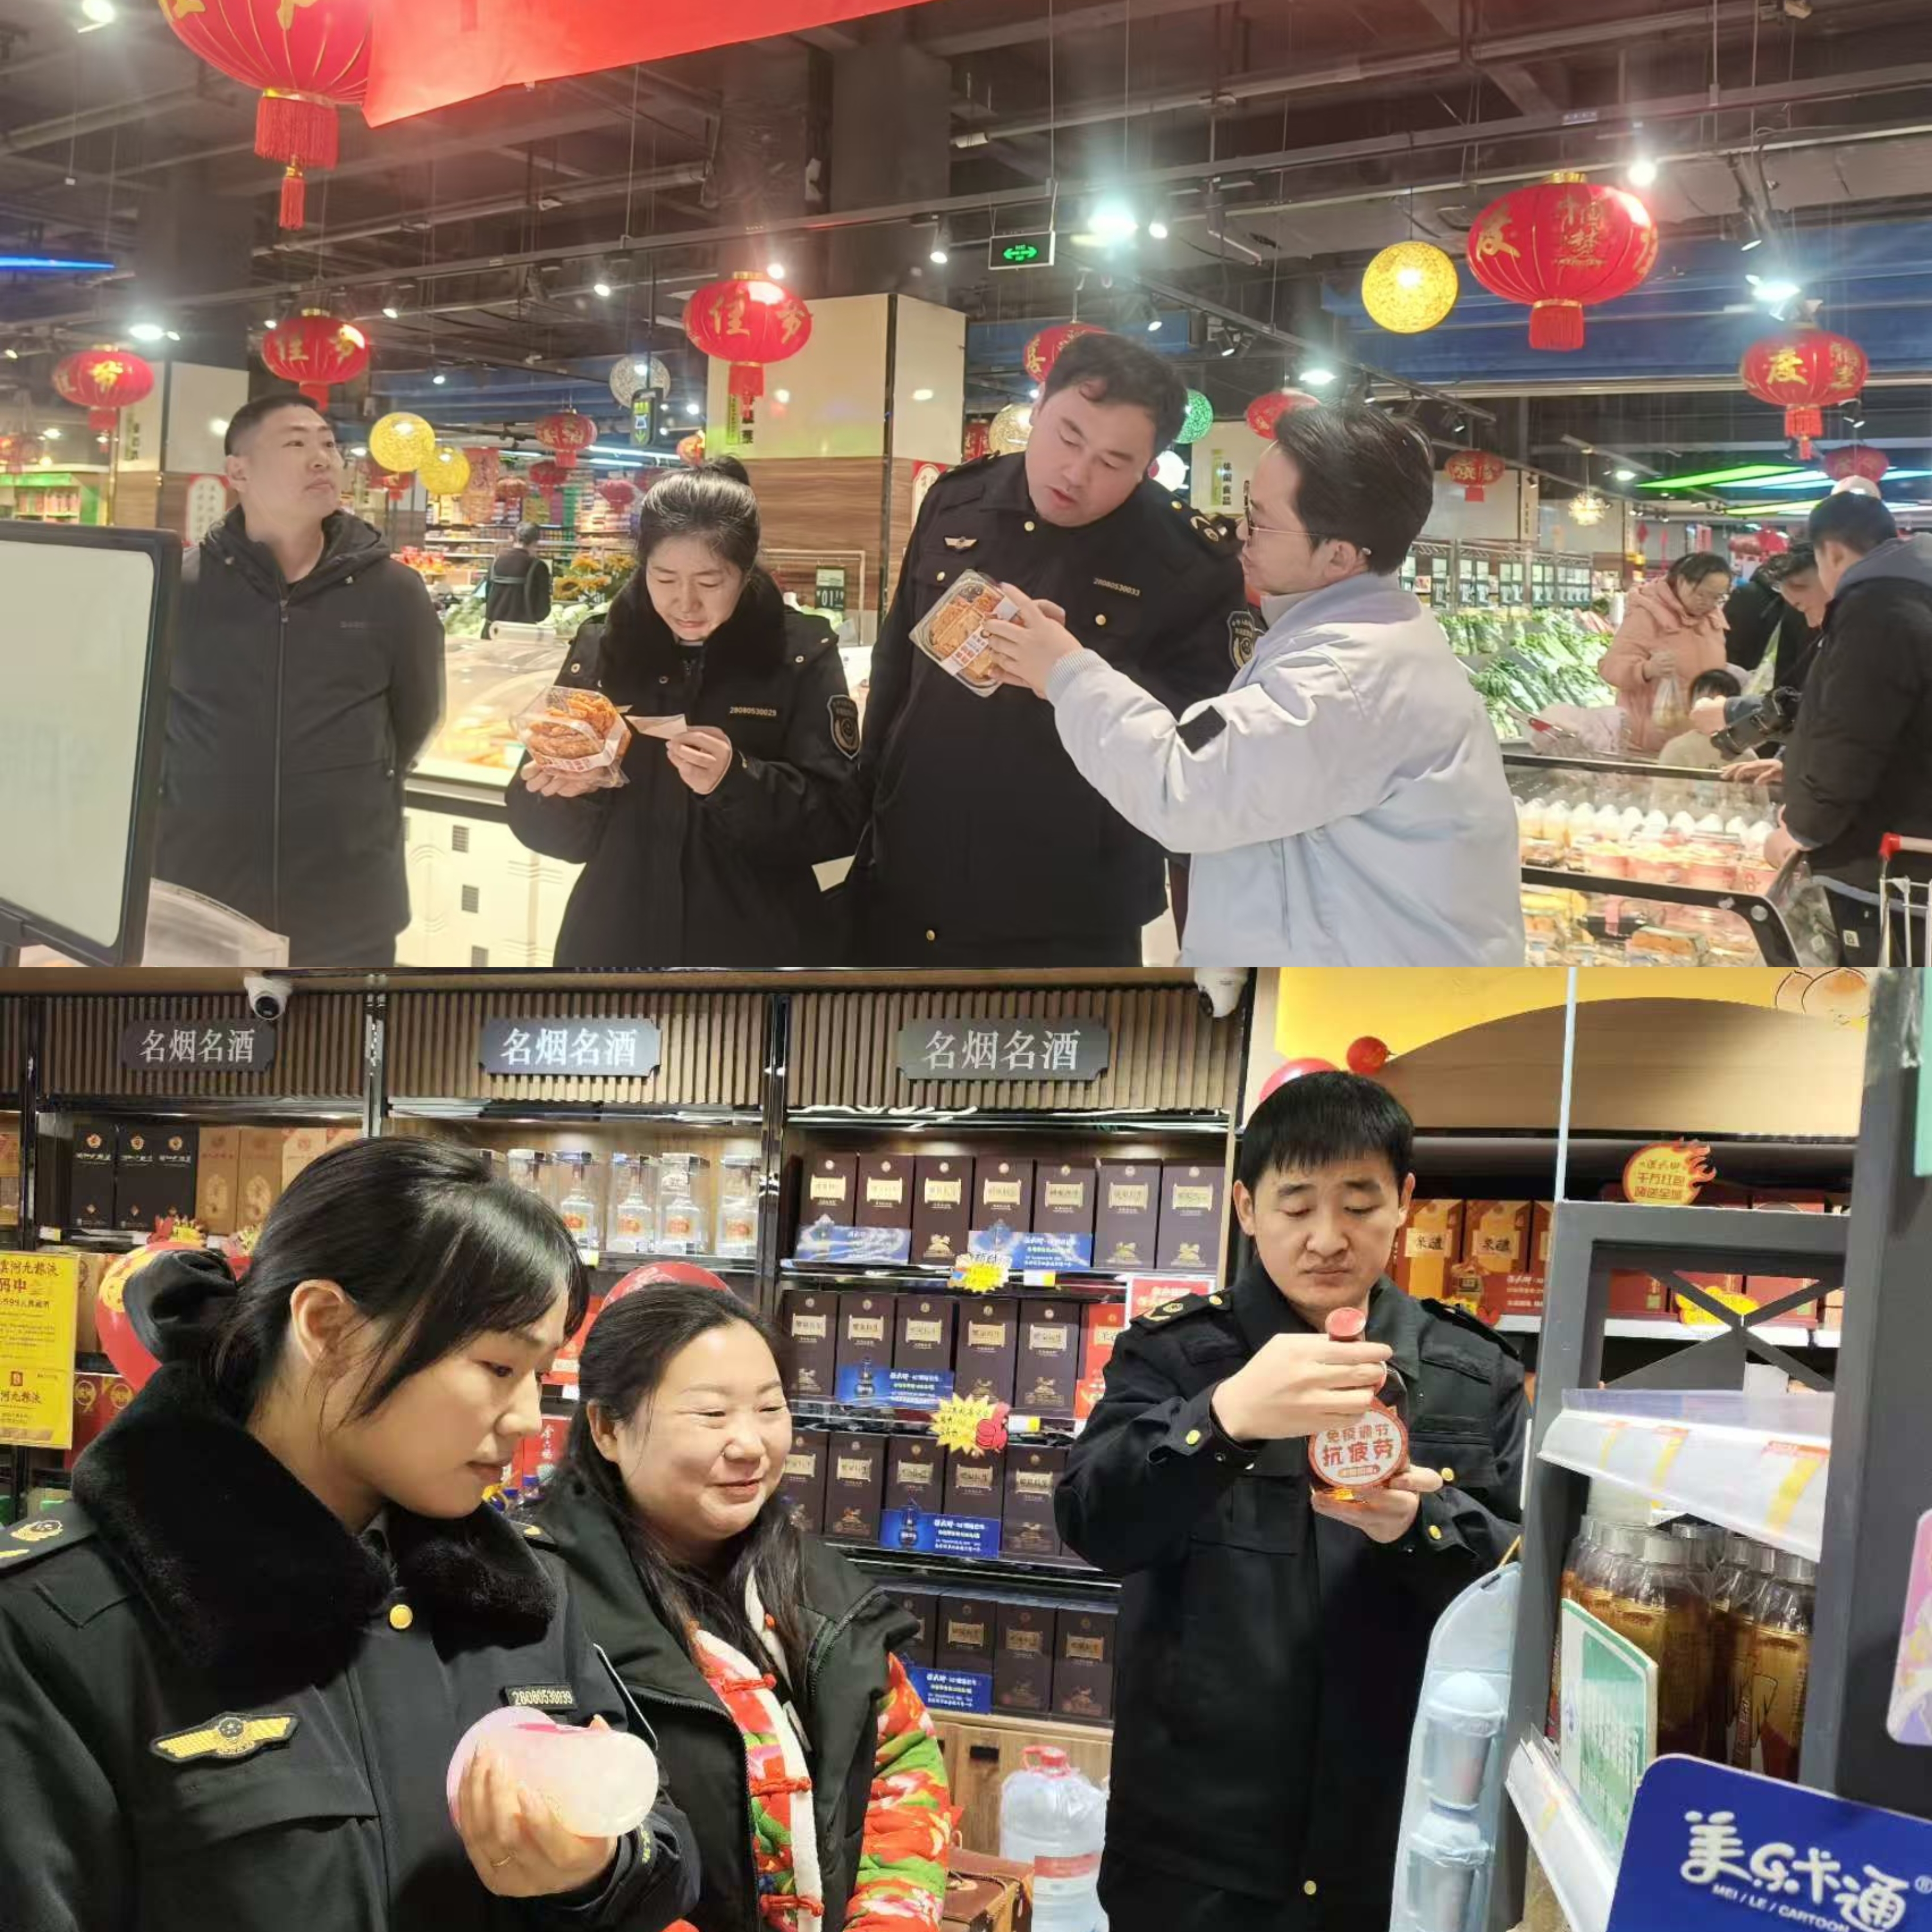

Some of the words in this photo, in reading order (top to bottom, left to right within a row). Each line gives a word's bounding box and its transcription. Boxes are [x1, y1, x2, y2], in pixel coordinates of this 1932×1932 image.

[140, 1028, 255, 1063] 名烟名酒
[500, 1027, 638, 1067] 名烟名酒
[922, 1029, 1081, 1071] 名烟名酒
[1327, 1423, 1390, 1442] 免疫调节
[1322, 1438, 1394, 1467] 抗疲劳
[1711, 1884, 1738, 1900] MEI
[1748, 1894, 1767, 1909] LE
[1778, 1905, 1850, 1932] CARTOON
